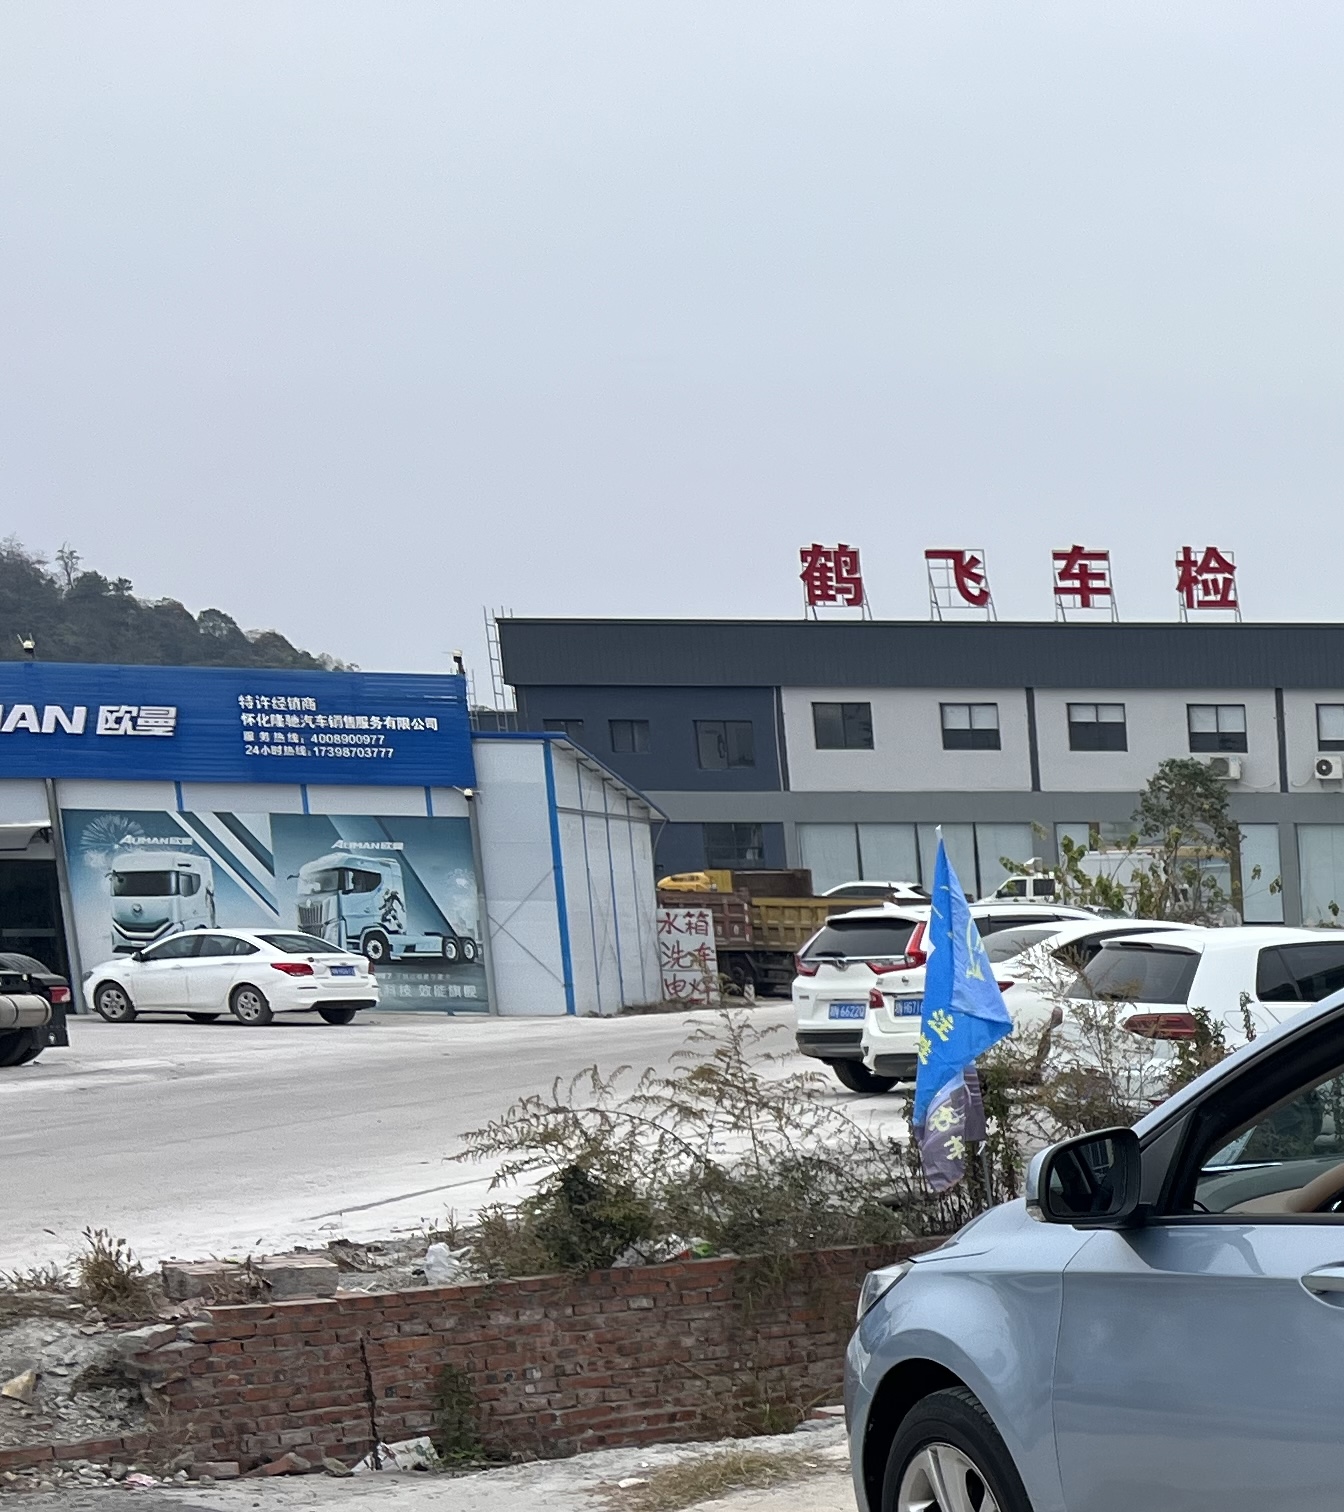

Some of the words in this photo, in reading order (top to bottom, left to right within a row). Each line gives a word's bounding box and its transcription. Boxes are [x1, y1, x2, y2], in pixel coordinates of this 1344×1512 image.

[799, 543, 1238, 609] 鹤飞车检
[0, 704, 88, 735] AN
[96, 705, 177, 736] 欧曼
[656, 910, 709, 936] 水箱
